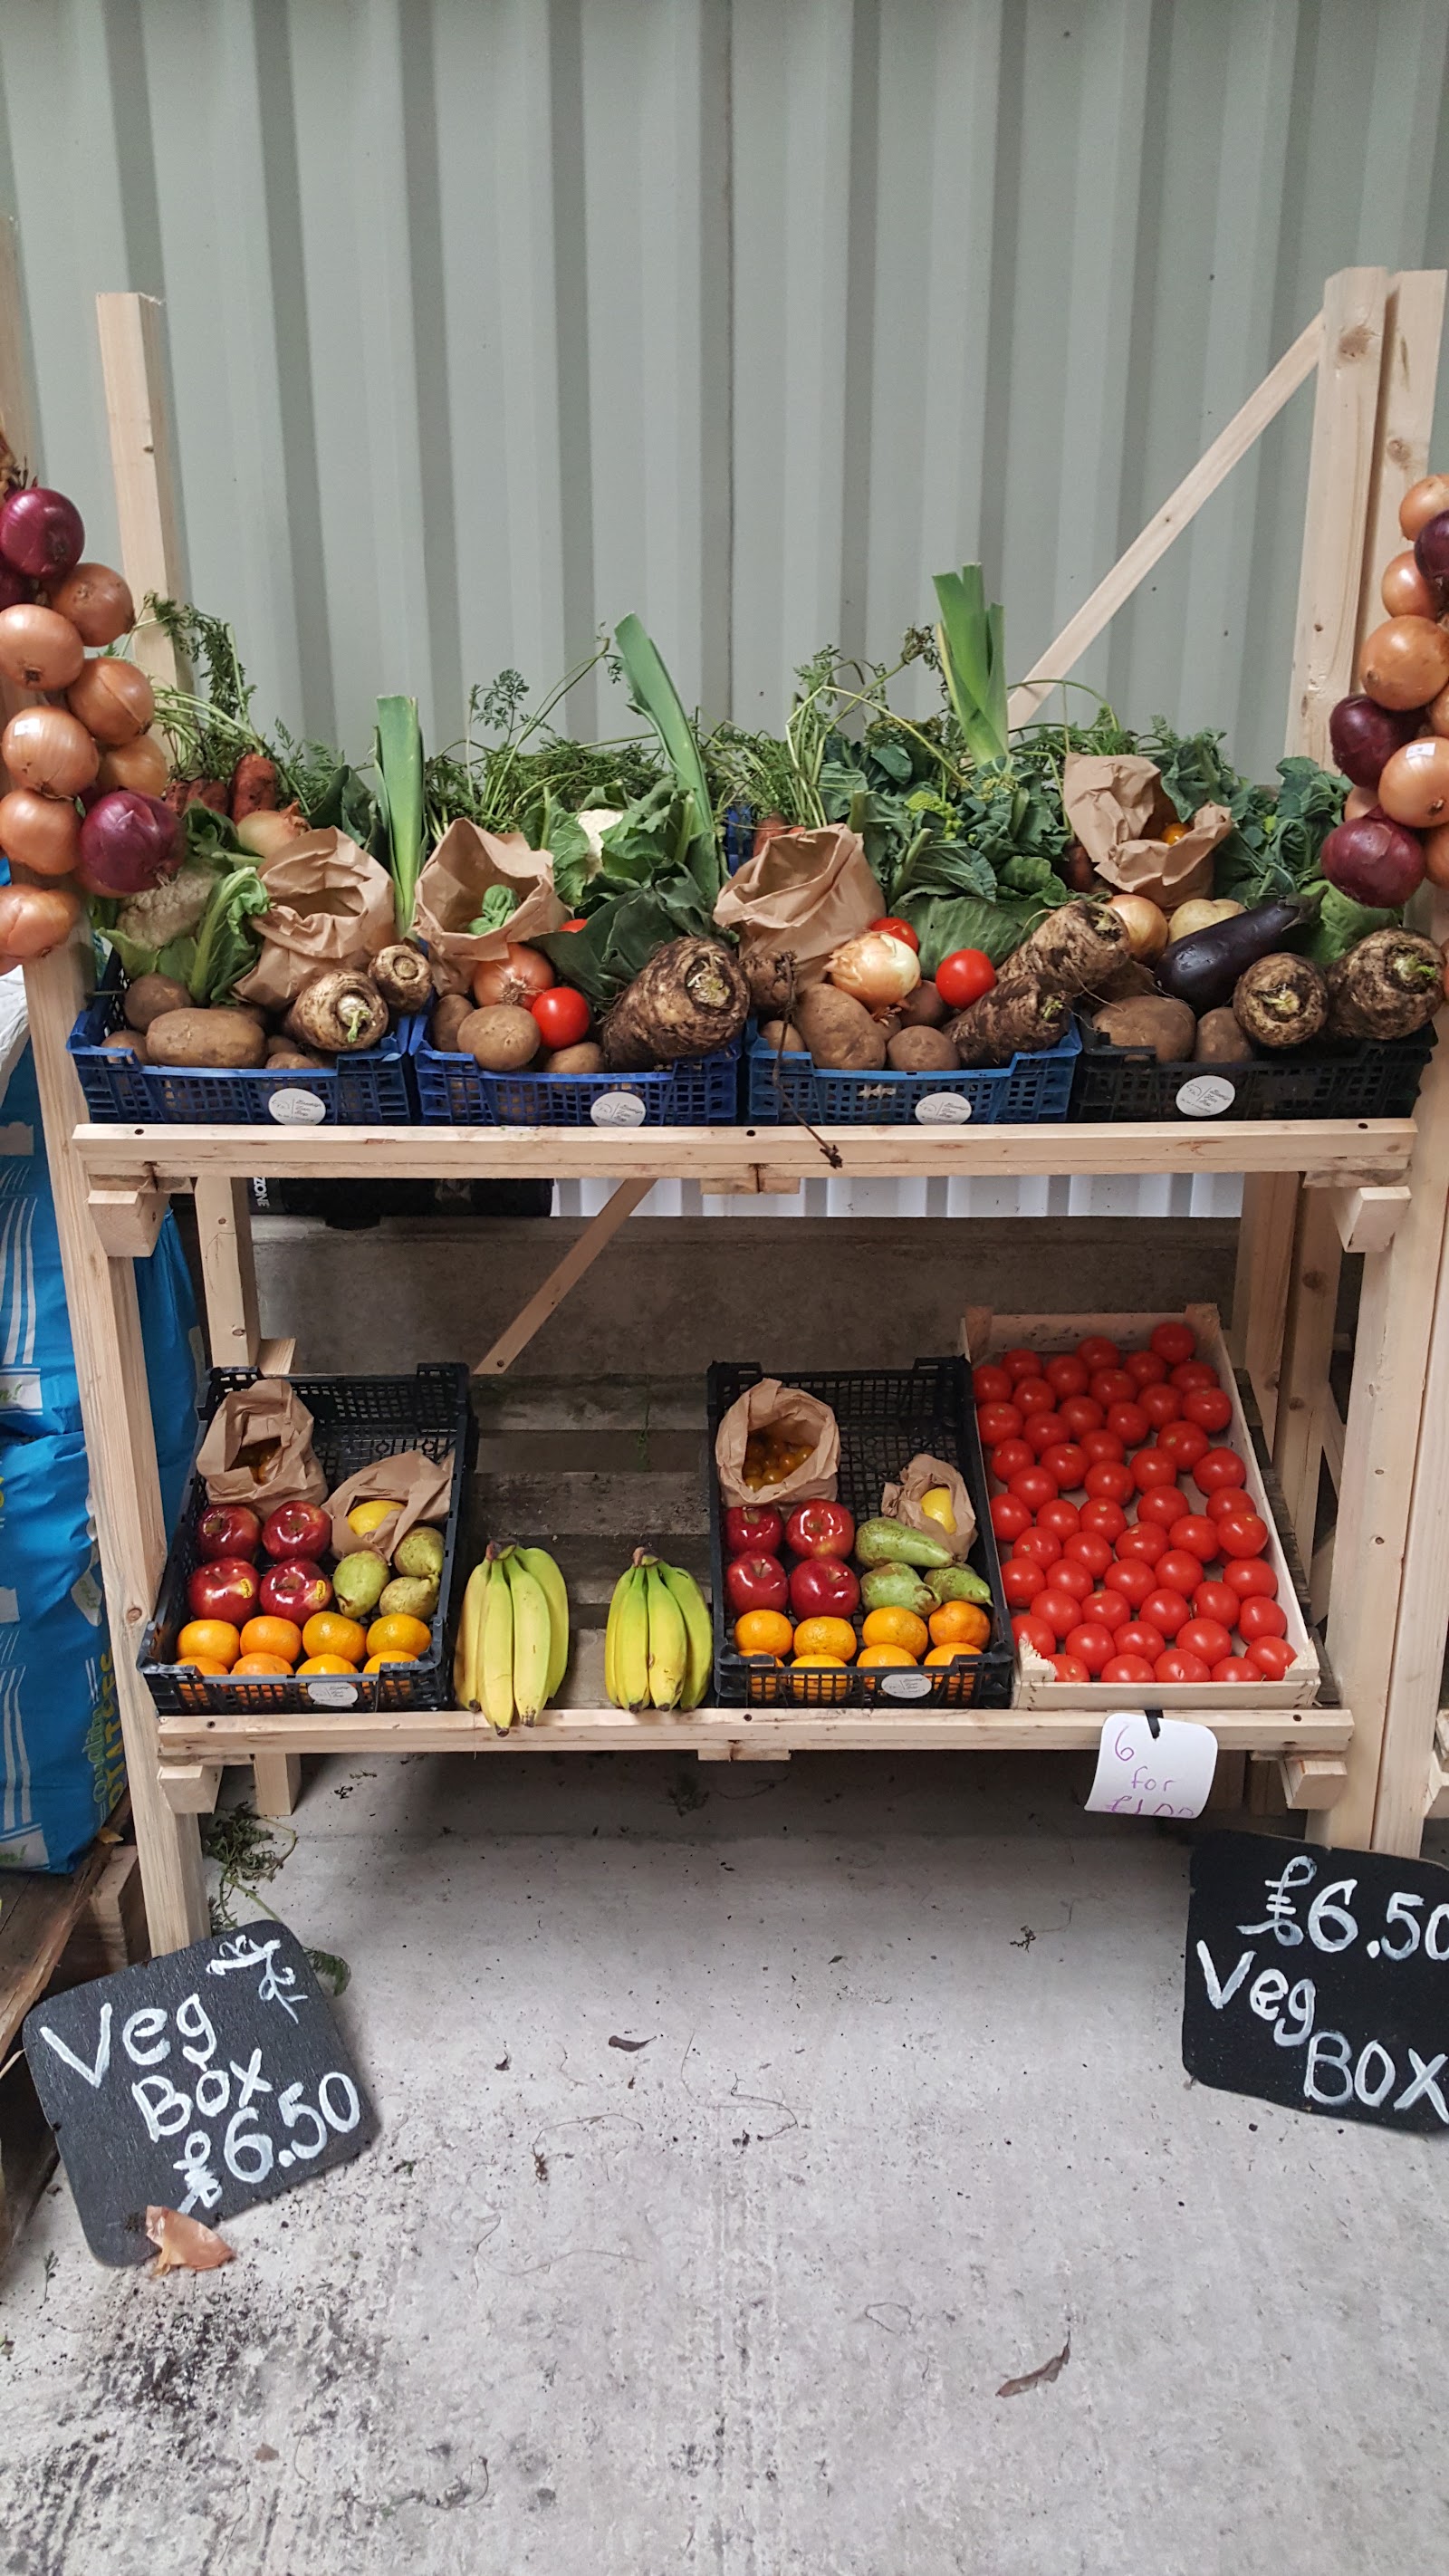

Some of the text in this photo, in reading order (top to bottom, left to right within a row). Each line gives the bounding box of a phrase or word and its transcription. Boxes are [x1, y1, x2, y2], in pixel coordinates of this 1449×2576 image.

[1114, 1725, 1135, 1762] 6
[1131, 1765, 1176, 1793] for
[1235, 1854, 1449, 1962] £6.50
[39, 1993, 217, 2089] Veg
[1195, 1938, 1317, 2048] Veg
[172, 2071, 362, 2216] £6.50
